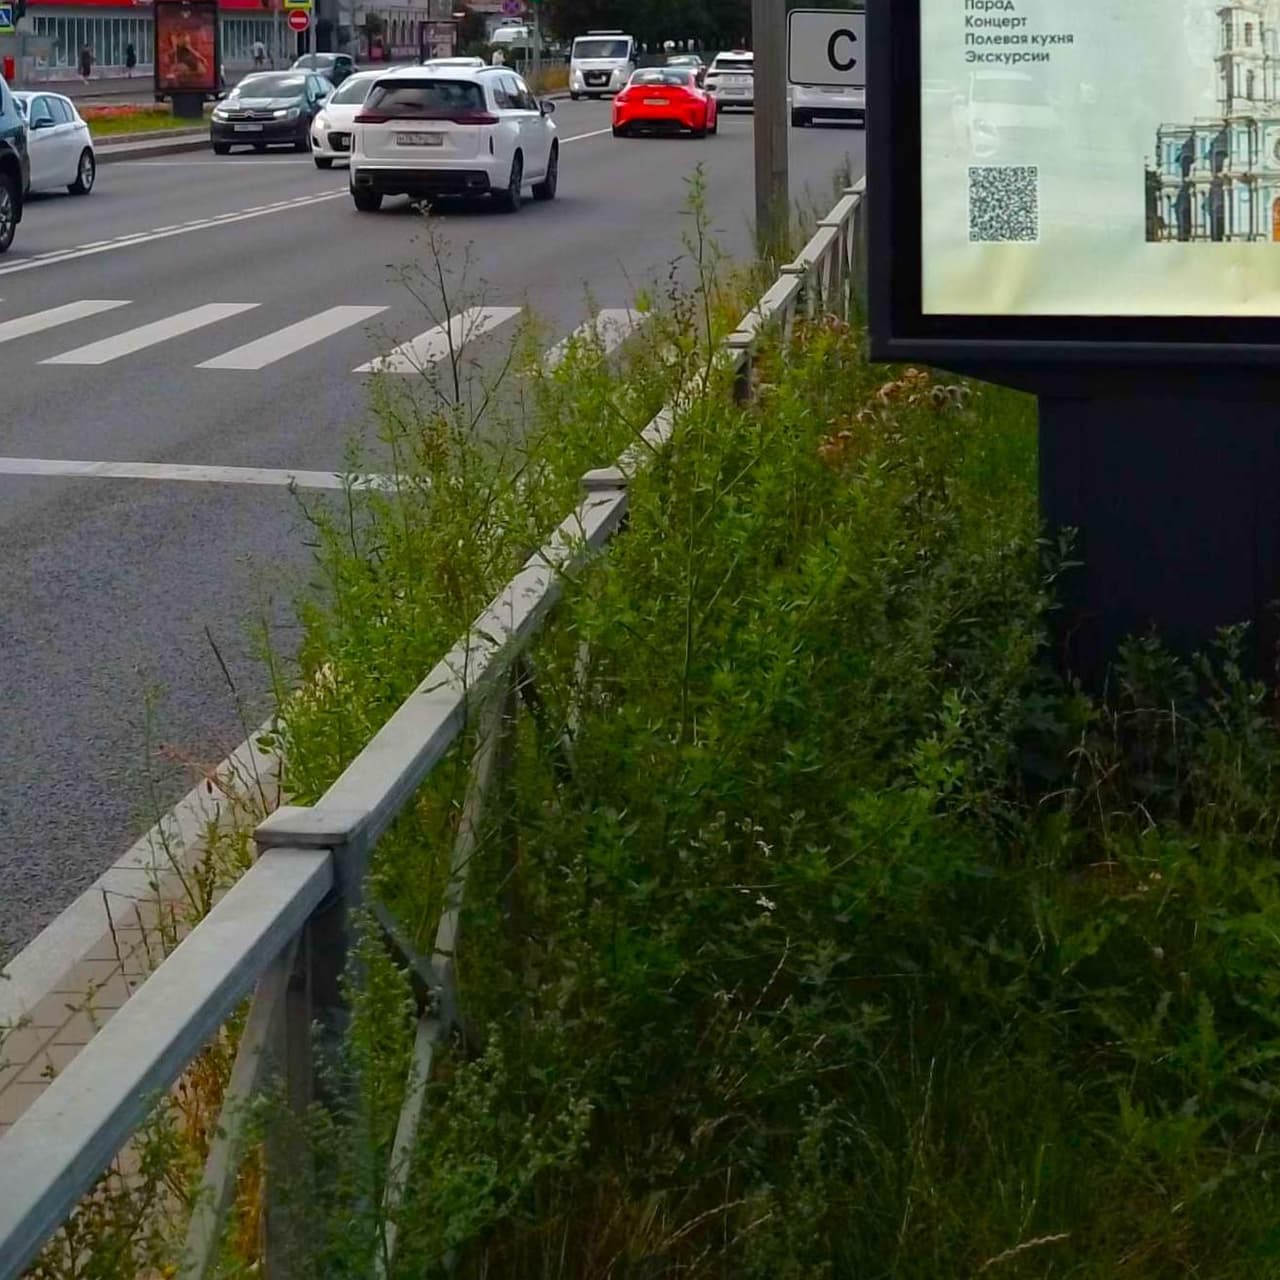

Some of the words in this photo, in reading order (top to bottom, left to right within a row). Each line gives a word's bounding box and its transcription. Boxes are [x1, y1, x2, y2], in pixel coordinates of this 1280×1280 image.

[964, 15, 1028, 29] Концерт
[964, 33, 1029, 45] Полевая
[1031, 34, 1074, 47] кухня
[964, 50, 1050, 65] Экскурсии
